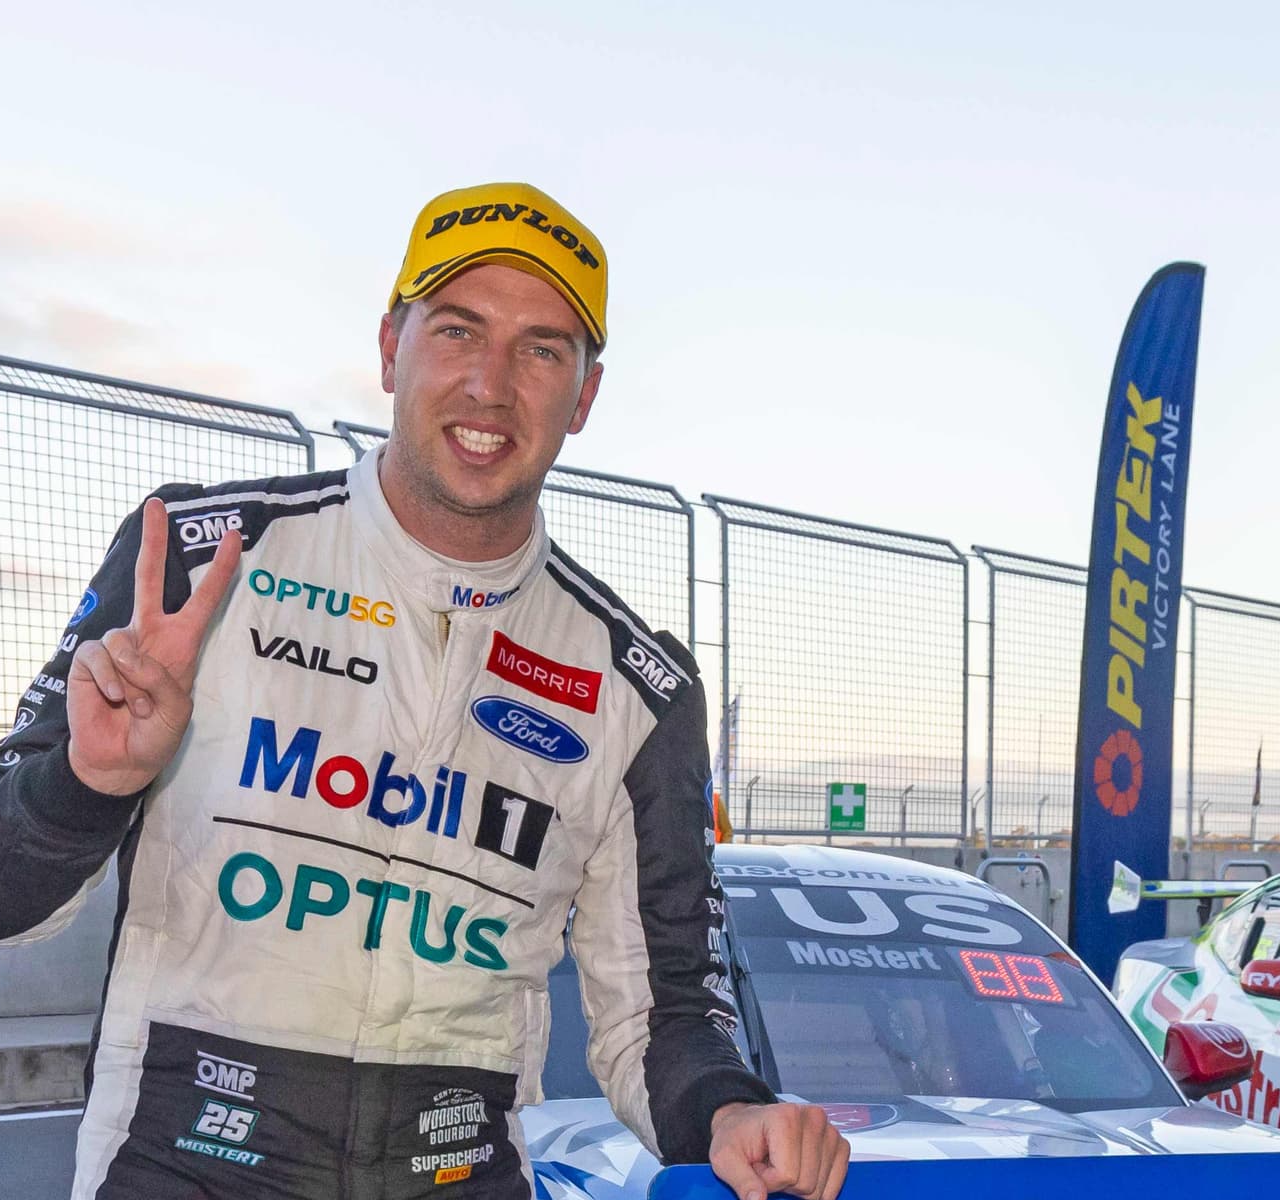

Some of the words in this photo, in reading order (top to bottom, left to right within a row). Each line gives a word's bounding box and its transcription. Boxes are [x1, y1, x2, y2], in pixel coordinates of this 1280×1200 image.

[425, 203, 599, 270] DUNLOP
[1161, 403, 1181, 493] LANE
[179, 515, 243, 544] OMP
[1106, 381, 1162, 729] PIRTEK
[1152, 500, 1173, 651] VICTORY
[250, 627, 378, 686] VAILO
[496, 648, 590, 702] MORRIS
[624, 644, 679, 693] OMP
[491, 704, 568, 757] Ford
[239, 717, 468, 839] Mobil
[496, 795, 530, 858] 1
[718, 864, 960, 888] ns.com.au
[217, 851, 510, 972] OPTUS
[786, 940, 943, 971] Mostert
[197, 1058, 256, 1092] OMP
[194, 1101, 256, 1143] 25
[419, 1101, 489, 1135] WOODSTOCK
[430, 1124, 479, 1145] BOURBON
[174, 1138, 265, 1166] MOSTERT
[411, 1144, 494, 1173] SUPERCHEAP
[439, 1169, 469, 1181] AUTO
